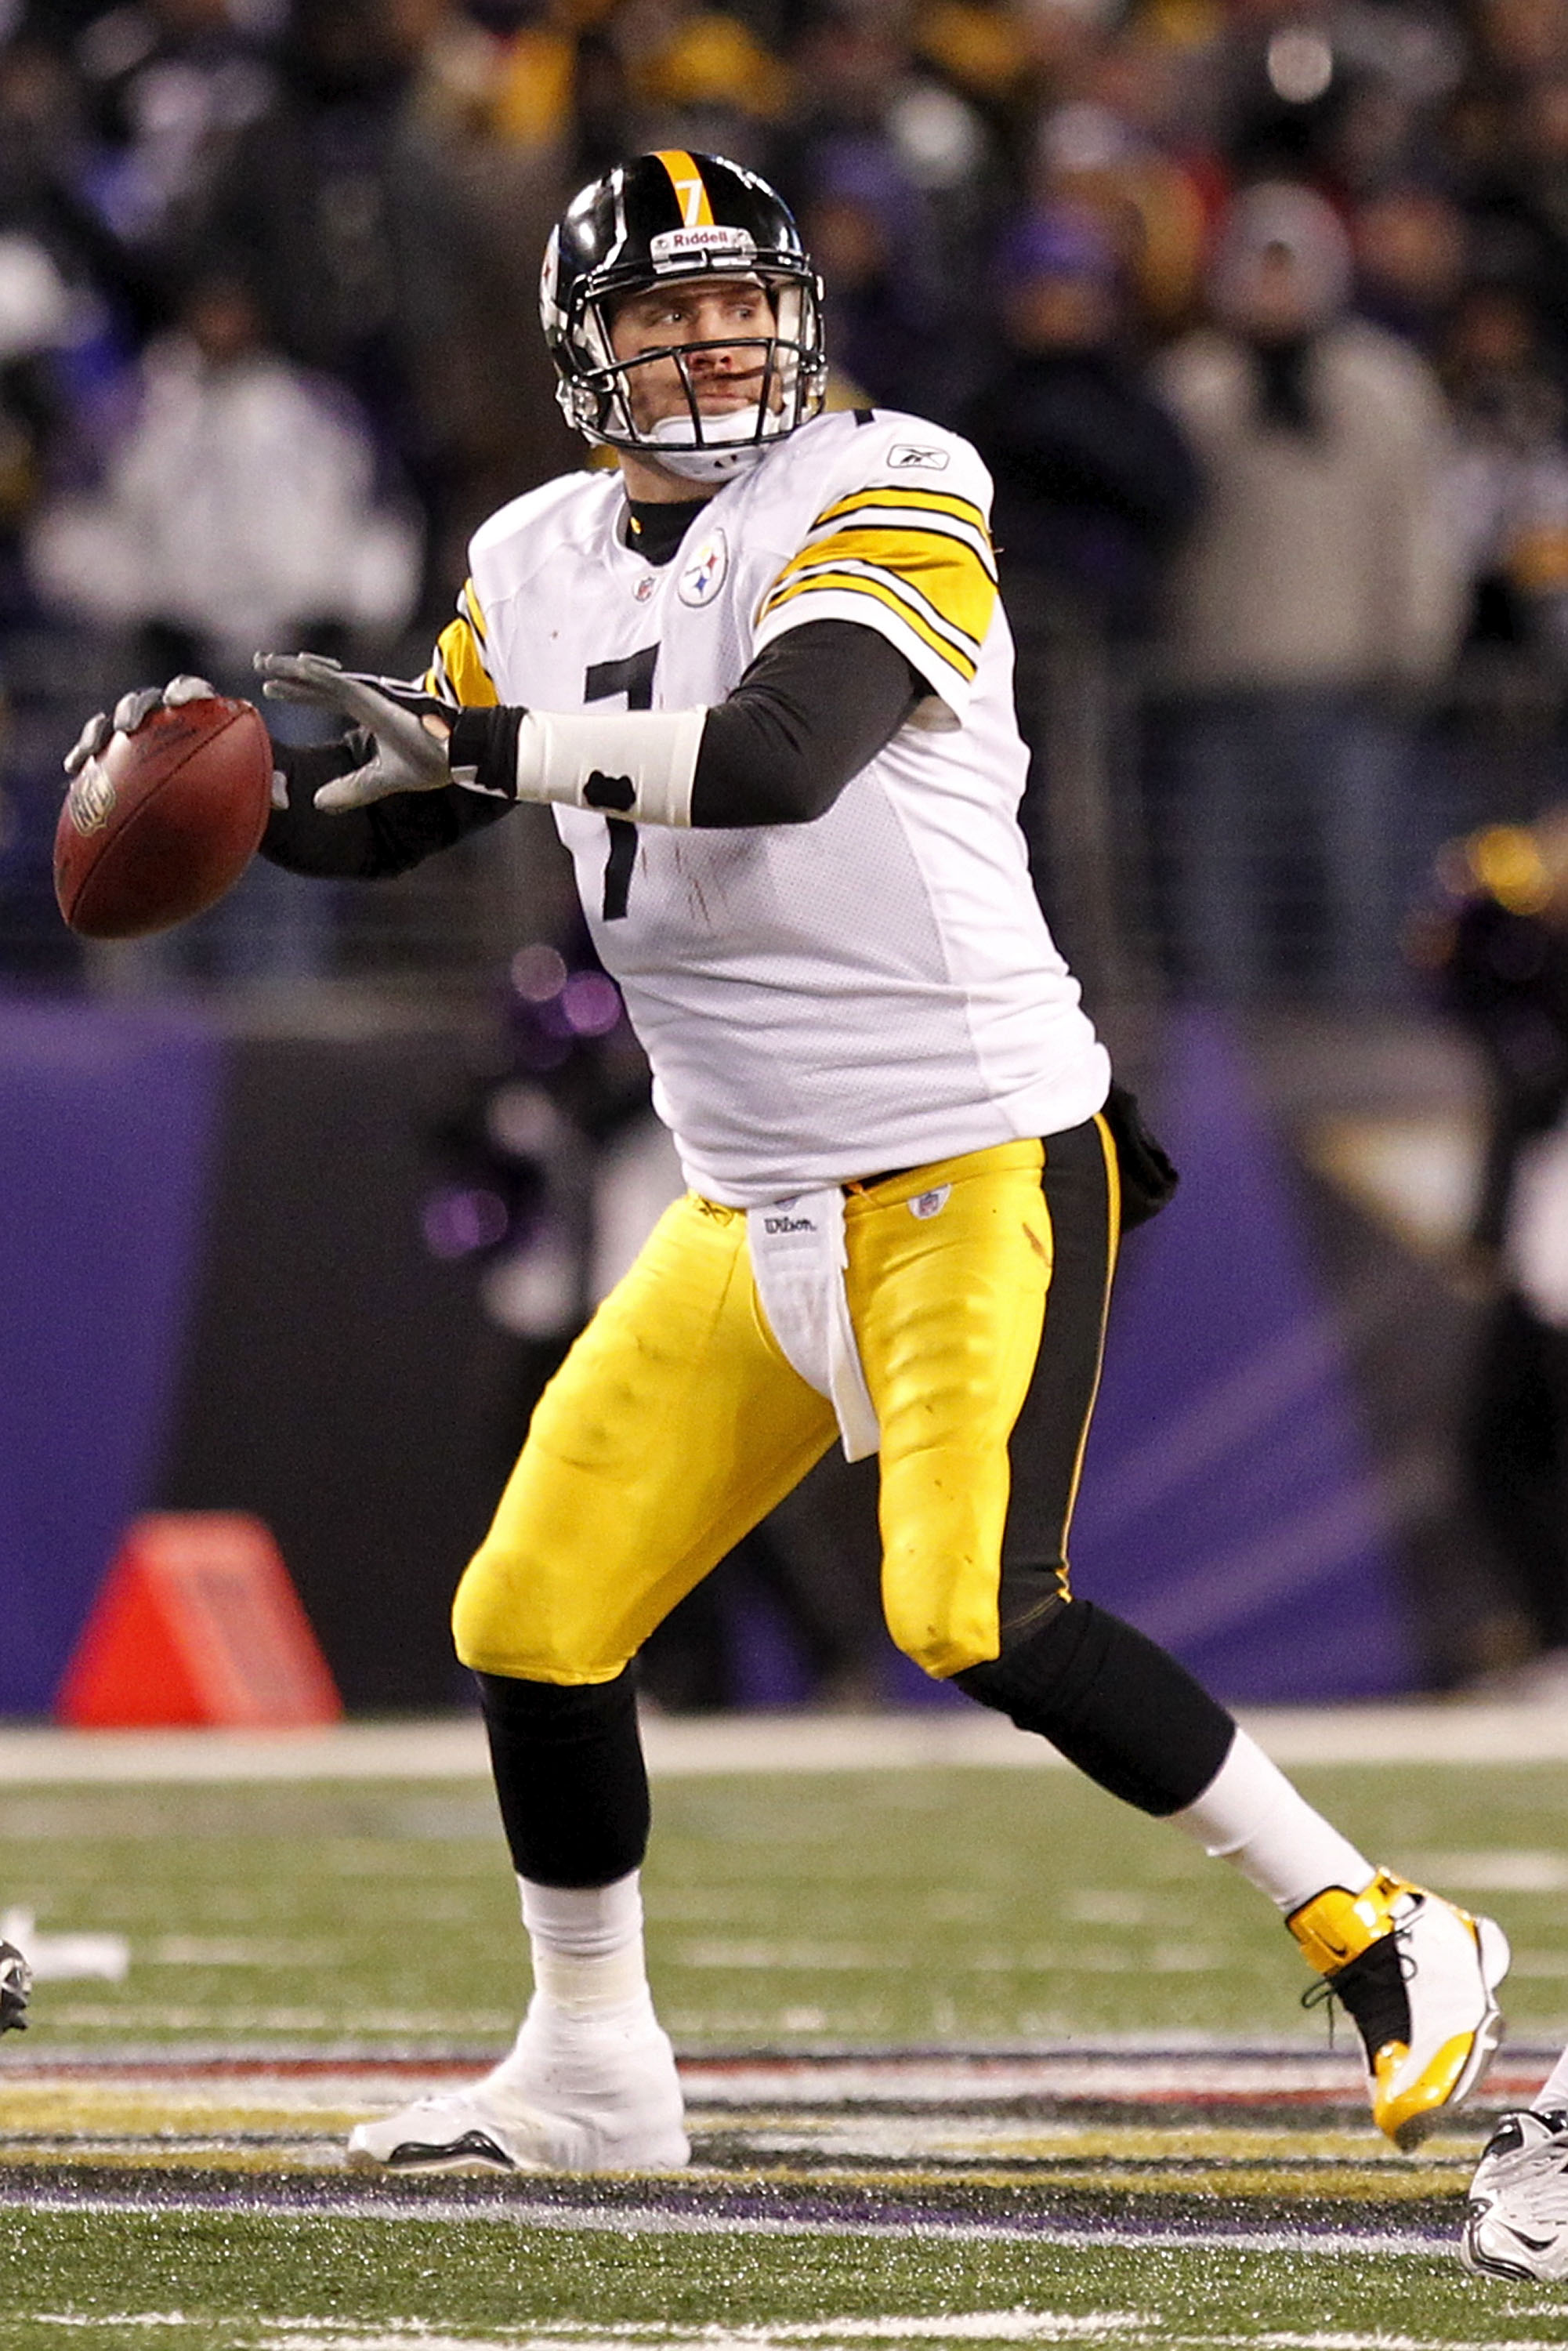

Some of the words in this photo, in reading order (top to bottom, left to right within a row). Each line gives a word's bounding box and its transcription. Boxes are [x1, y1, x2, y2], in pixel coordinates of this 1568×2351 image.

[674, 179, 703, 226] 7
[673, 230, 728, 247] Riddell
[584, 640, 661, 919] 7
[764, 1215, 817, 1234] Wilson
